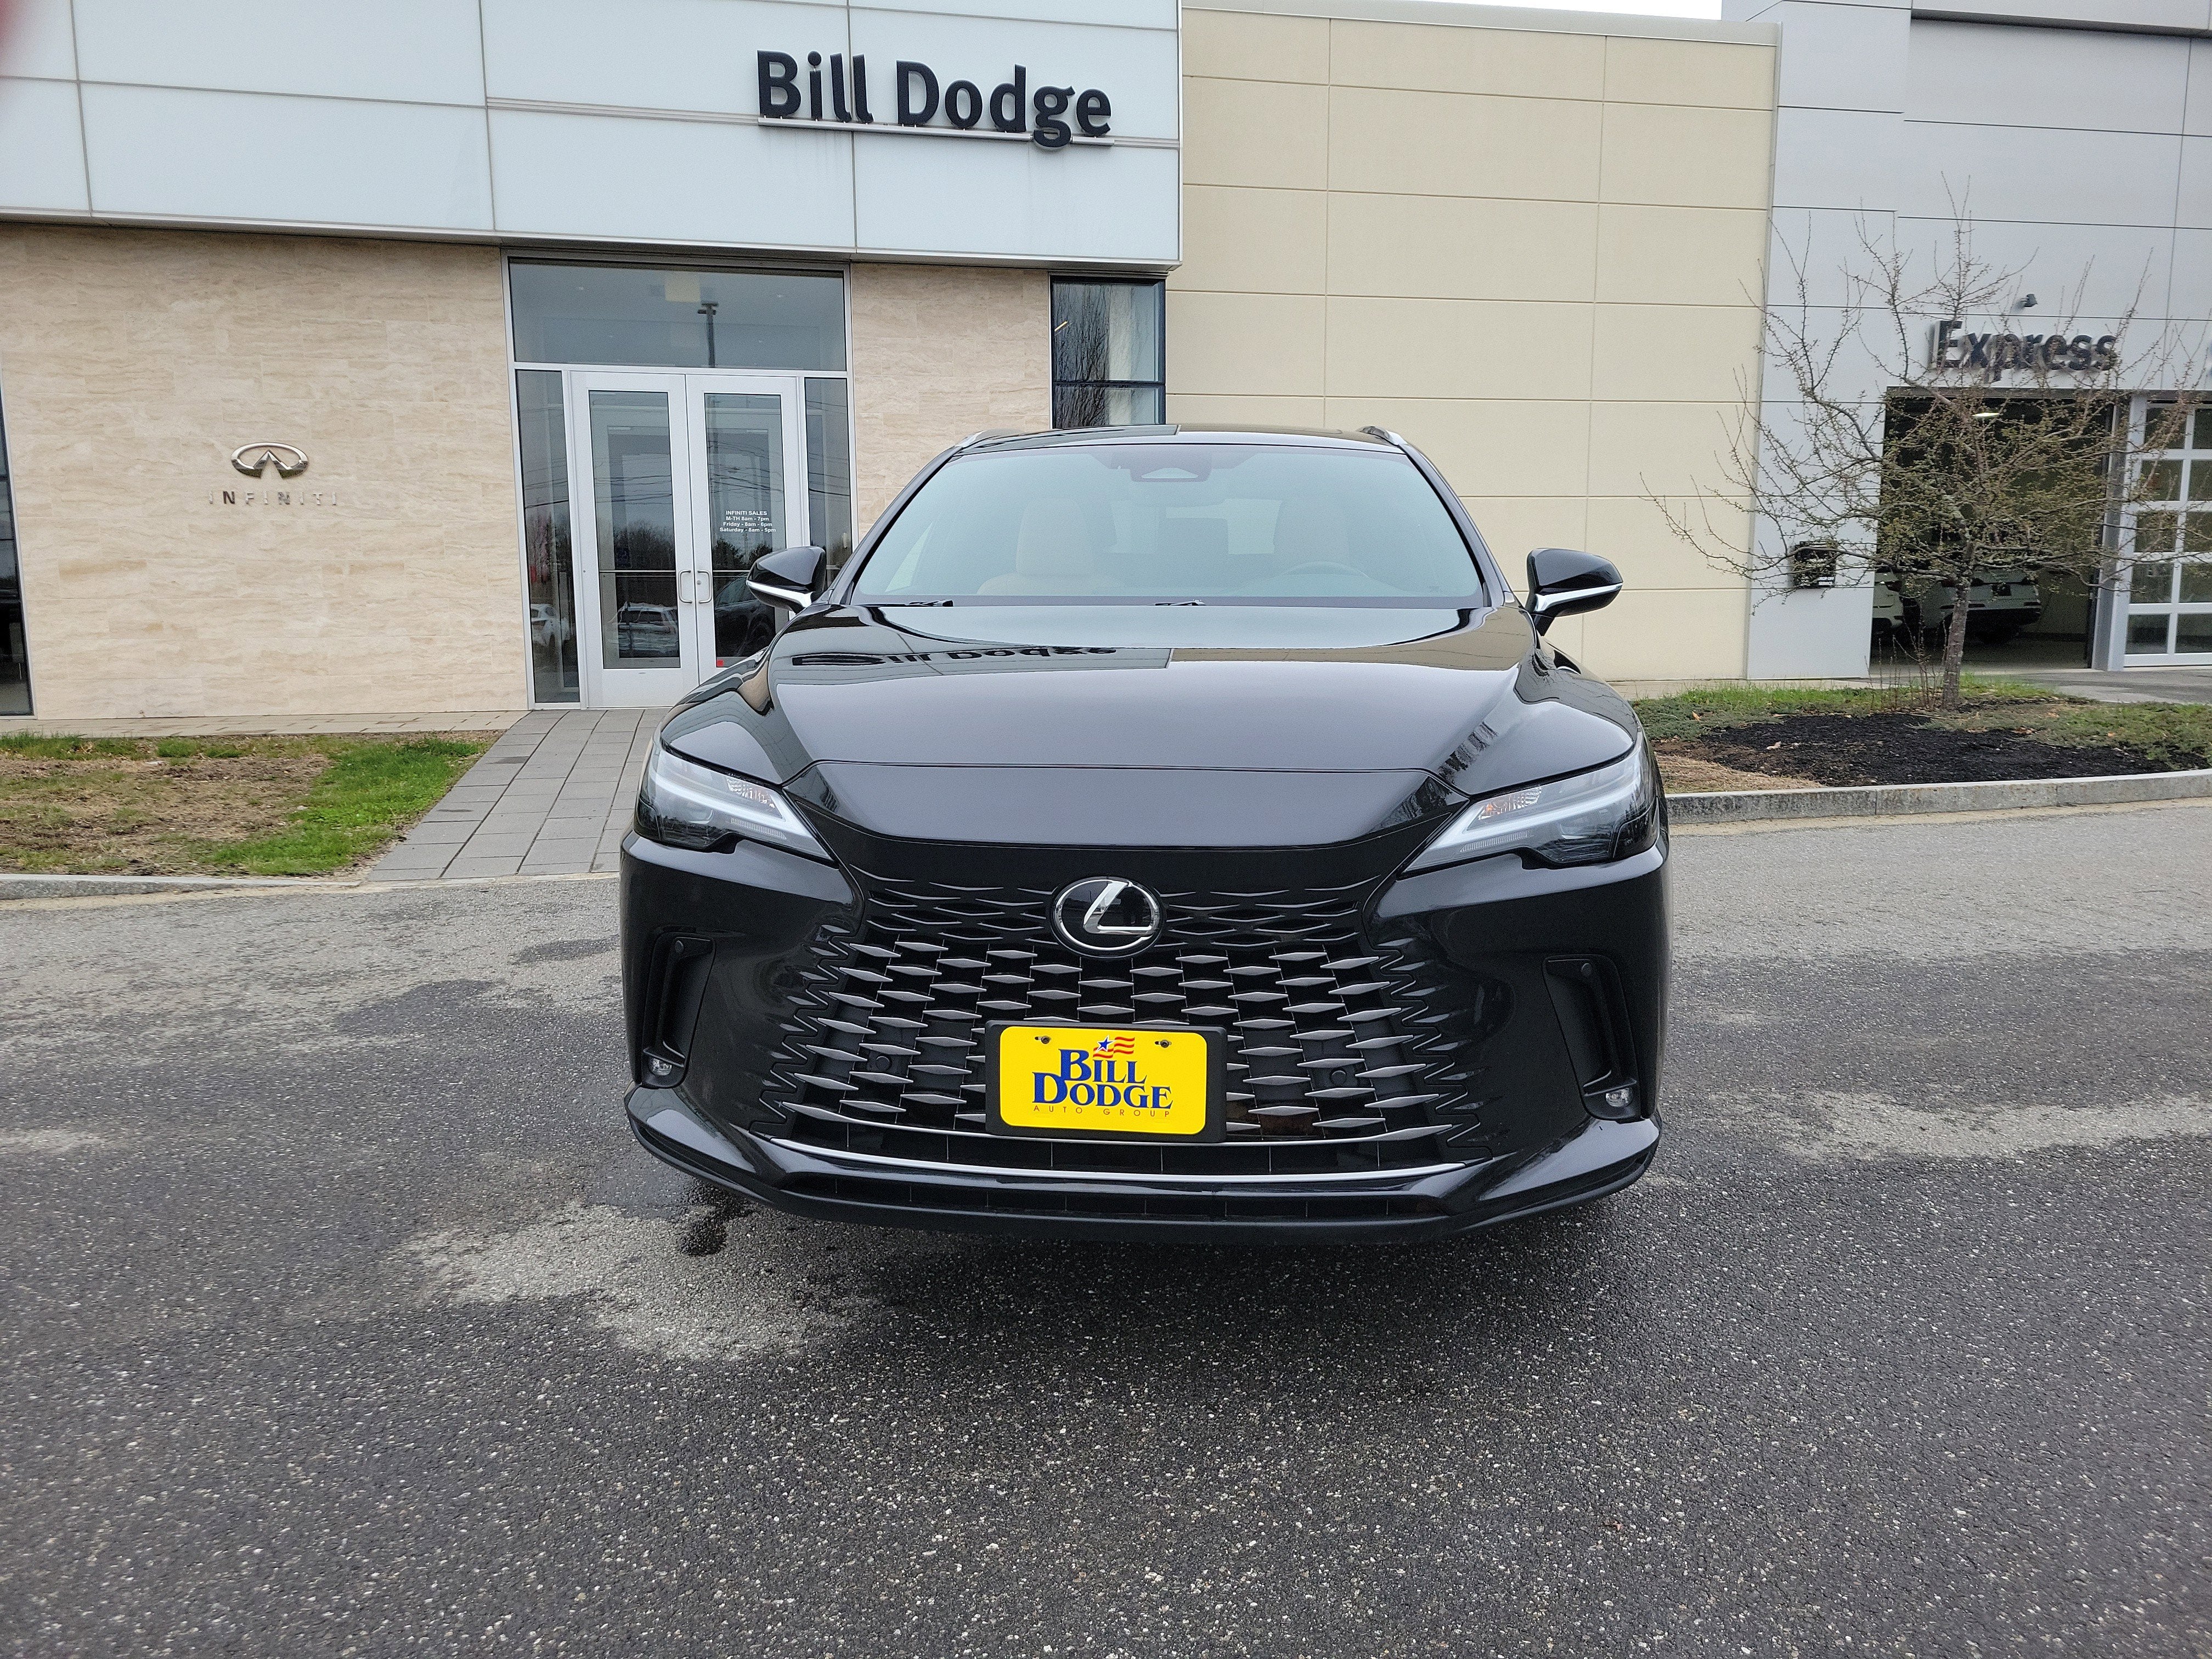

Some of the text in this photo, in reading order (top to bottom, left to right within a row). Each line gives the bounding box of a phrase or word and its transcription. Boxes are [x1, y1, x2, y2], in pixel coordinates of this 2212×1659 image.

[757, 49, 1112, 148] Bill Dodge
[1933, 320, 2118, 382] Express
[208, 490, 337, 506] INFINITI
[1058, 1048, 1148, 1084] BILL
[1032, 1071, 1173, 1109] DODGE
[1033, 1105, 1170, 1118] AUTO GROUP
